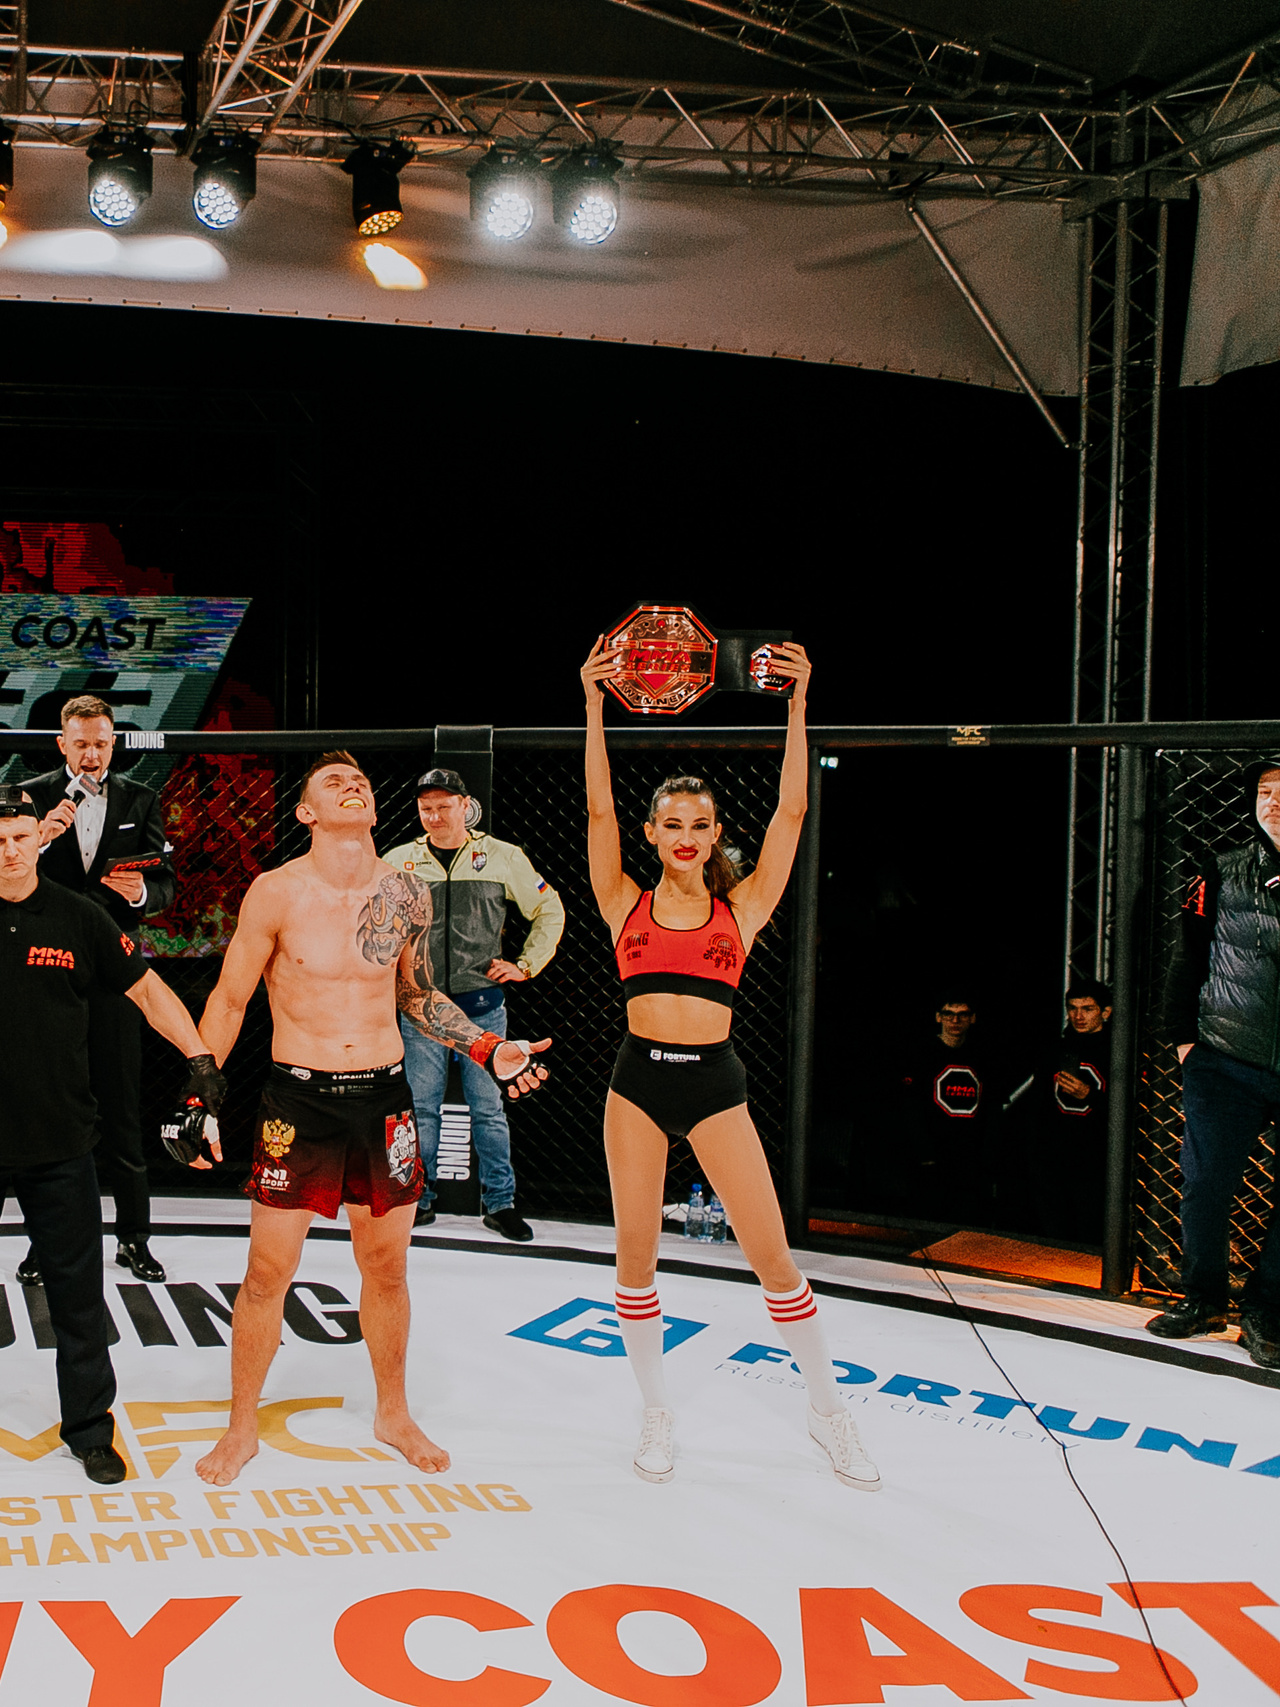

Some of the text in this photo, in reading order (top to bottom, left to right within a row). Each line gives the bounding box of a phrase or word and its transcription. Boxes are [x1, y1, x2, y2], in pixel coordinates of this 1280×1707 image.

[10, 614, 167, 650] COAST
[628, 649, 691, 664] MMA
[626, 661, 691, 673] SERIES
[124, 732, 165, 749] LUDING
[28, 946, 75, 963] MMA
[26, 957, 75, 970] SERIES
[663, 1052, 701, 1061] FORTUNA
[946, 1085, 975, 1093] MMA
[436, 1104, 472, 1180] LUDING
[260, 1178, 290, 1187] SPORT
[713, 1362, 869, 1405] Russn
[202, 1482, 533, 1521] FIGHTING
[333, 1580, 1280, 1707] COAST
